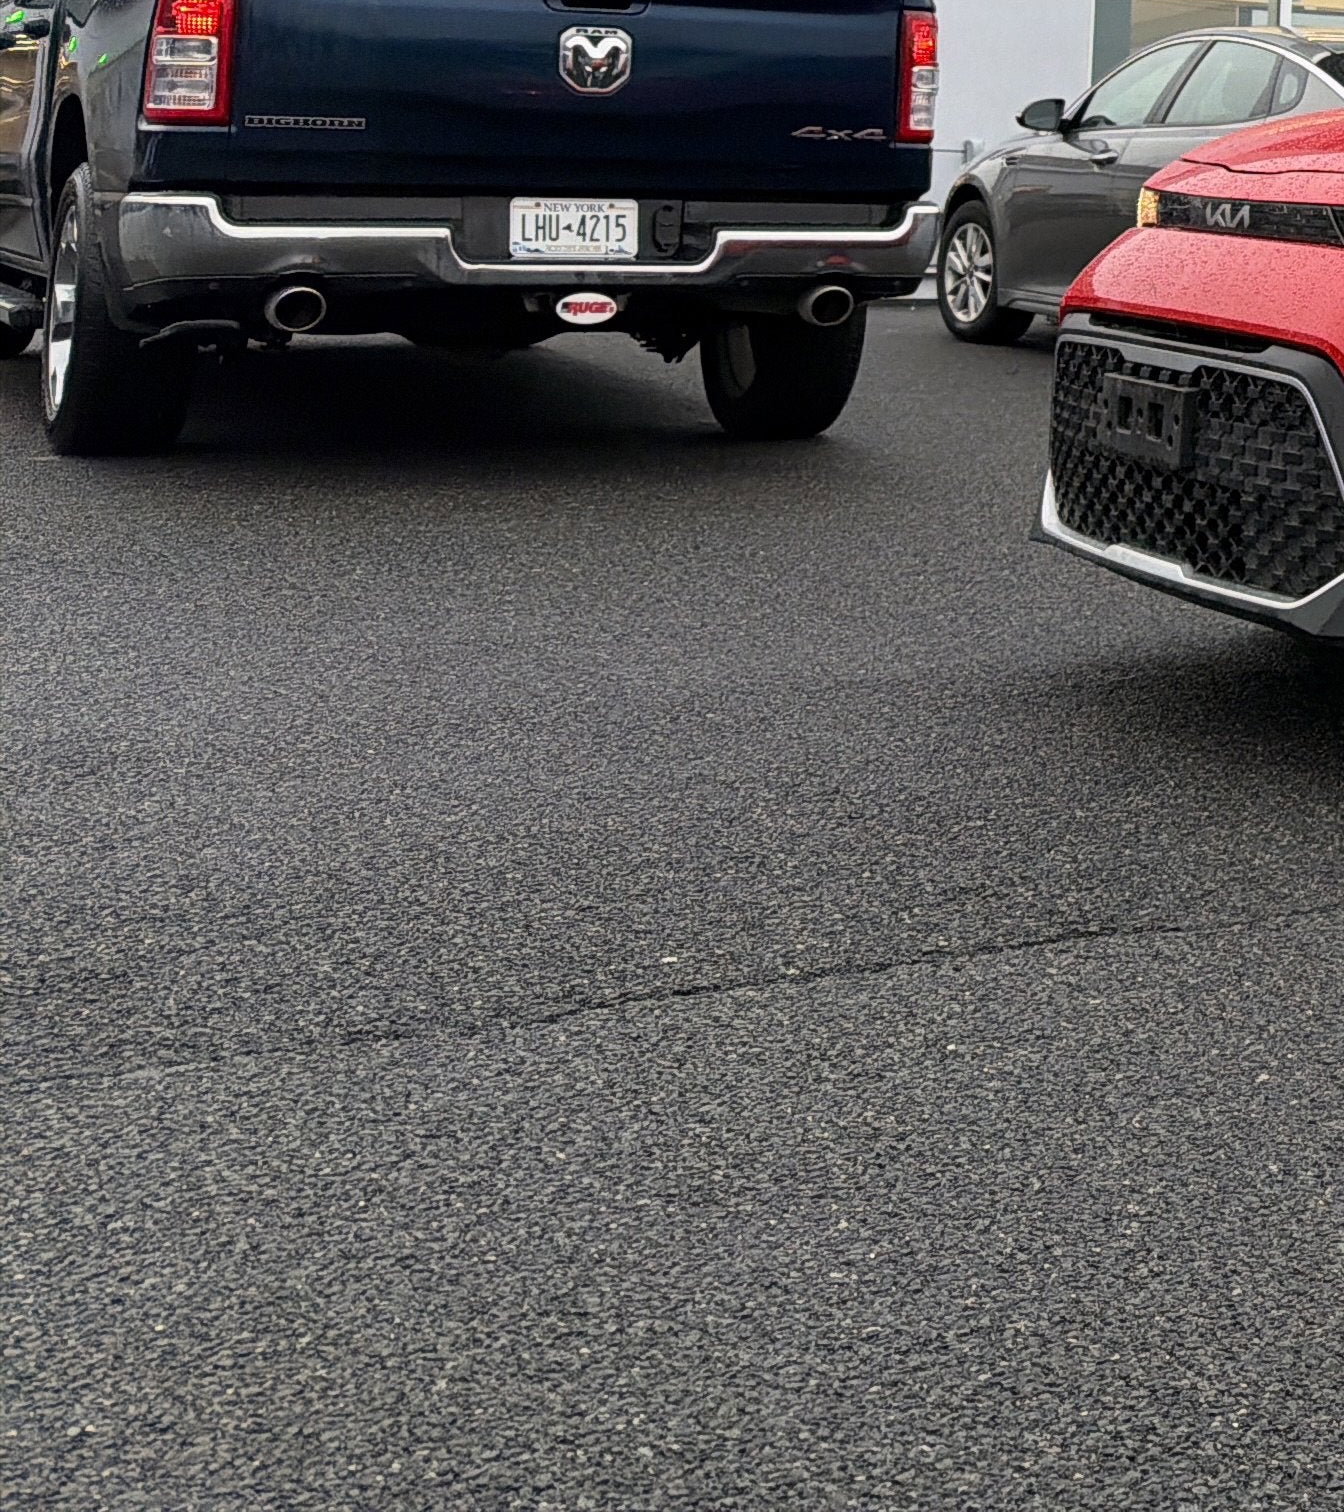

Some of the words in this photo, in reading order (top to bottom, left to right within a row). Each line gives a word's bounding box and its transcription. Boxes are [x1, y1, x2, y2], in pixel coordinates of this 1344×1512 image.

[543, 202, 571, 212] NEW
[574, 202, 606, 213] YORK
[1205, 201, 1251, 230] KIA
[521, 213, 560, 242] LHU
[576, 214, 627, 243] 4215
